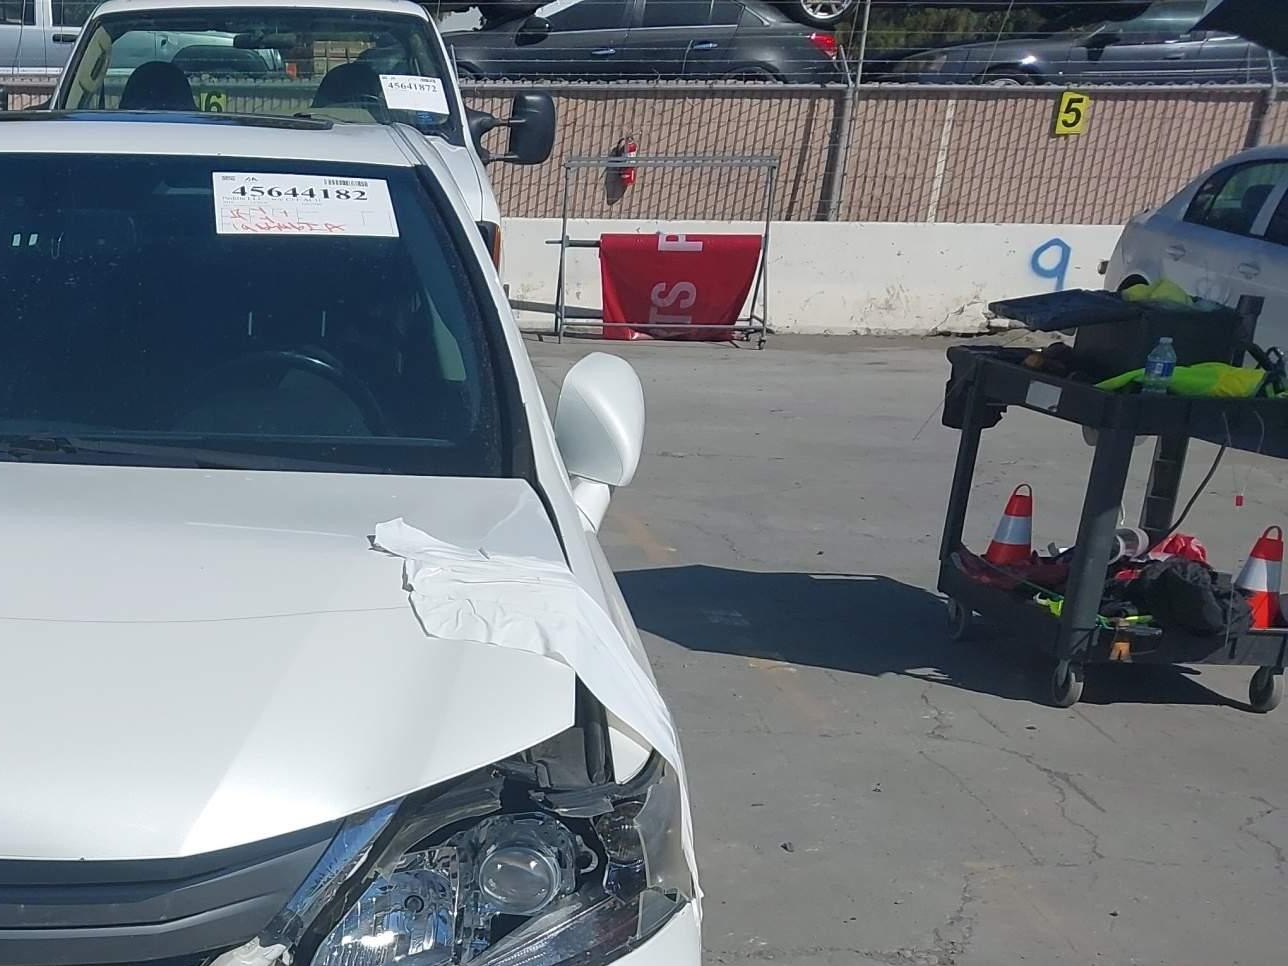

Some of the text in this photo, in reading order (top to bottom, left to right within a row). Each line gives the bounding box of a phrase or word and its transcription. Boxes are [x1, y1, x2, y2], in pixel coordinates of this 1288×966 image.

[387, 81, 439, 93] 45641872
[204, 90, 223, 113] 6
[1061, 97, 1084, 128] 5
[231, 184, 369, 201] 45644182
[1030, 237, 1072, 292] 9
